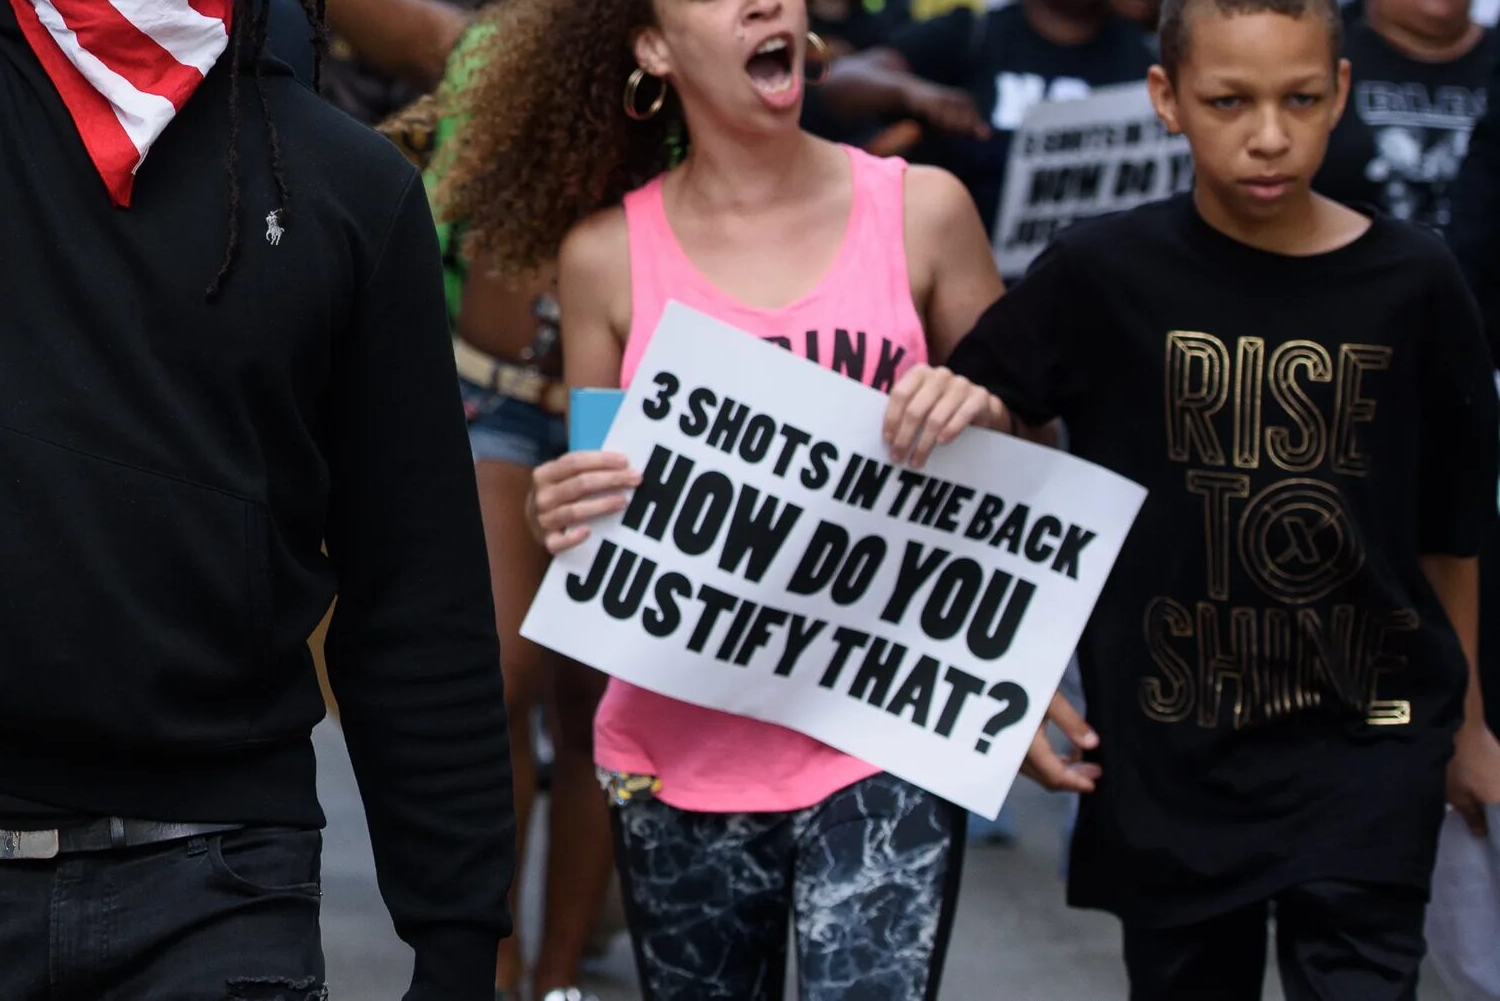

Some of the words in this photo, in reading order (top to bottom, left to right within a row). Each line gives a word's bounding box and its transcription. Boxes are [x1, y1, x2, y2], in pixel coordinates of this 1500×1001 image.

[1029, 160, 1104, 207] HOW
[1113, 158, 1155, 196] DO
[641, 370, 681, 422] 3
[678, 386, 839, 492] SHOTS
[832, 452, 900, 512] IN
[886, 470, 976, 533] THE
[962, 492, 1099, 582] BACK
[1163, 329, 1394, 478] RISE
[620, 443, 804, 585] HOW
[785, 518, 889, 607] DO
[879, 538, 1038, 662] YOU
[1186, 469, 1367, 605] TO
[565, 539, 828, 678] JUSTIFY
[818, 625, 1030, 756] THAT?
[1138, 596, 1420, 731] SHINE
